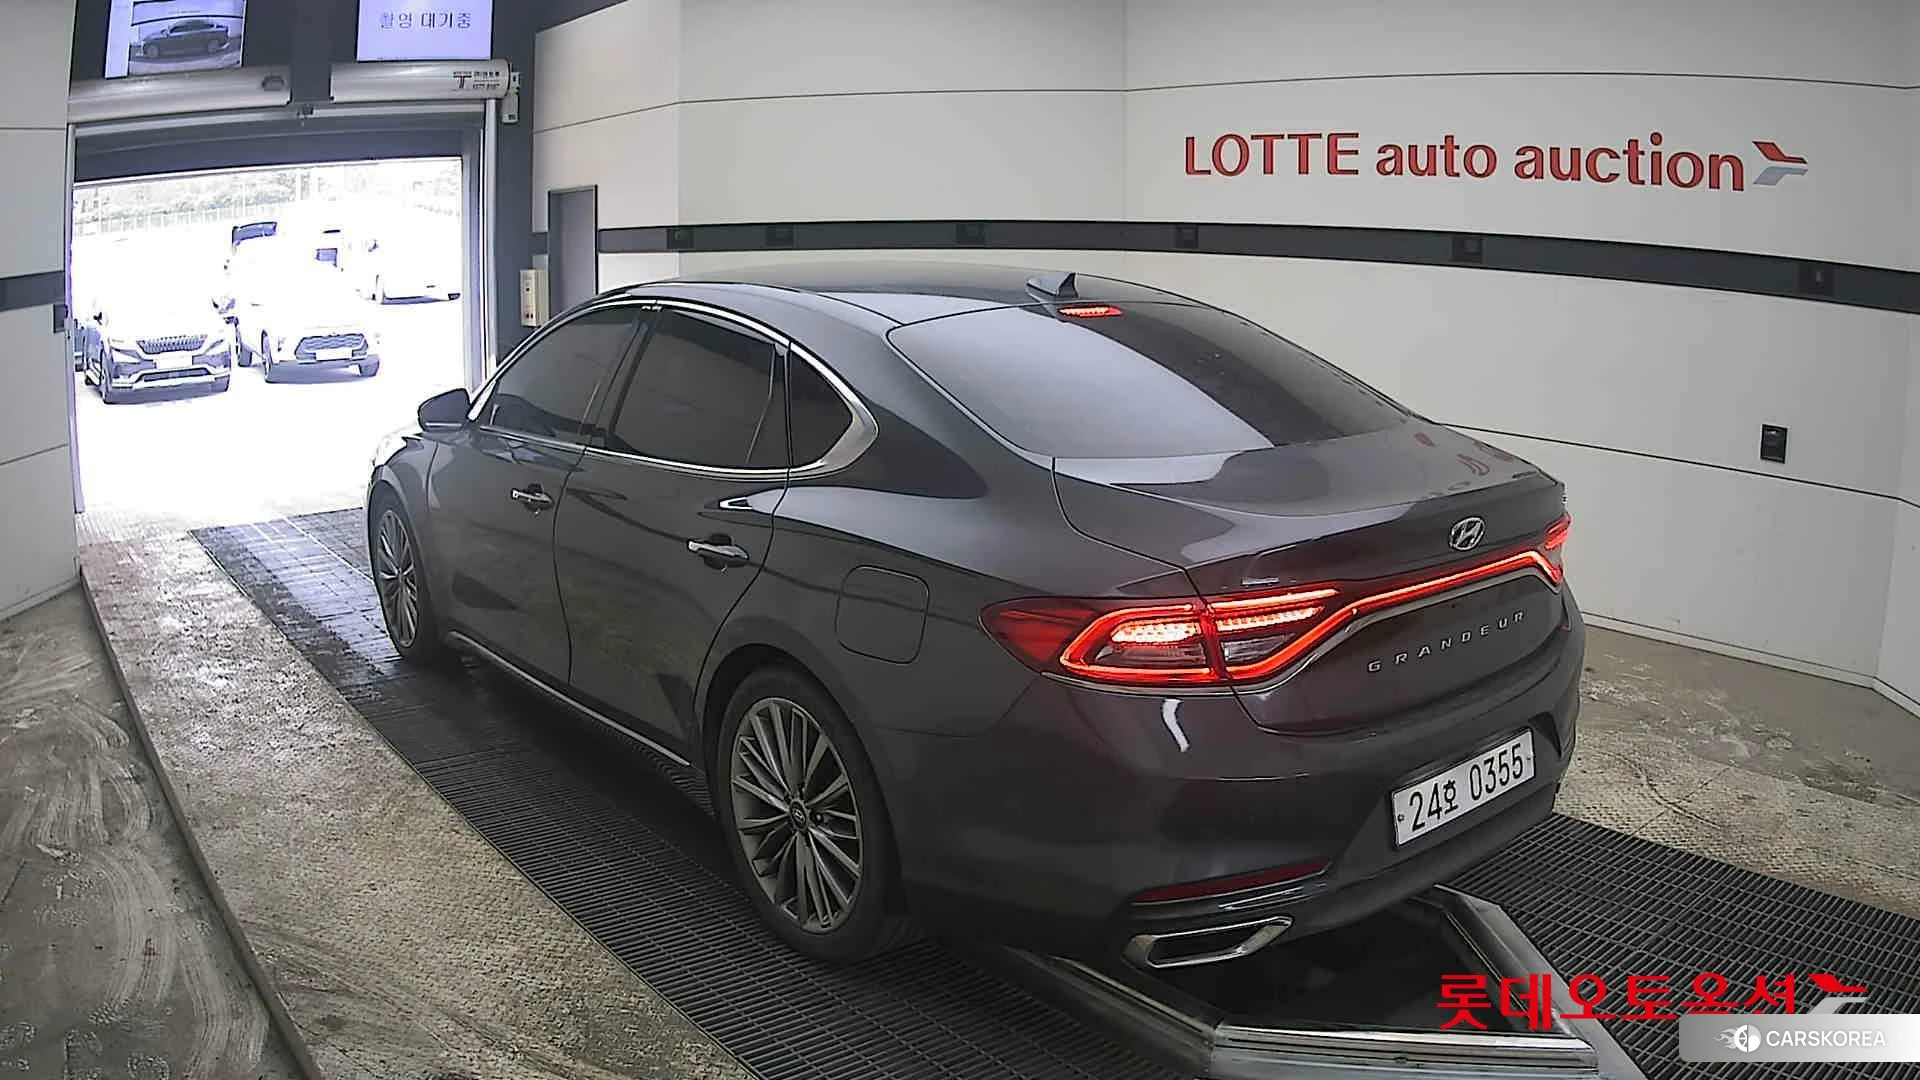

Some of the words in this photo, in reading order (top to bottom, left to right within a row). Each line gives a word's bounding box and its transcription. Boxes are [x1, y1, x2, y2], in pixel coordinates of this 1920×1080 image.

[420, 12, 472, 29] 대기중
[1184, 131, 1361, 177] LOTTE
[1375, 134, 1498, 179] auto
[1513, 131, 1746, 192] auction
[1367, 610, 1525, 673] GRANDEUR
[1407, 778, 1460, 833] 24호
[1468, 742, 1525, 801] 0355
